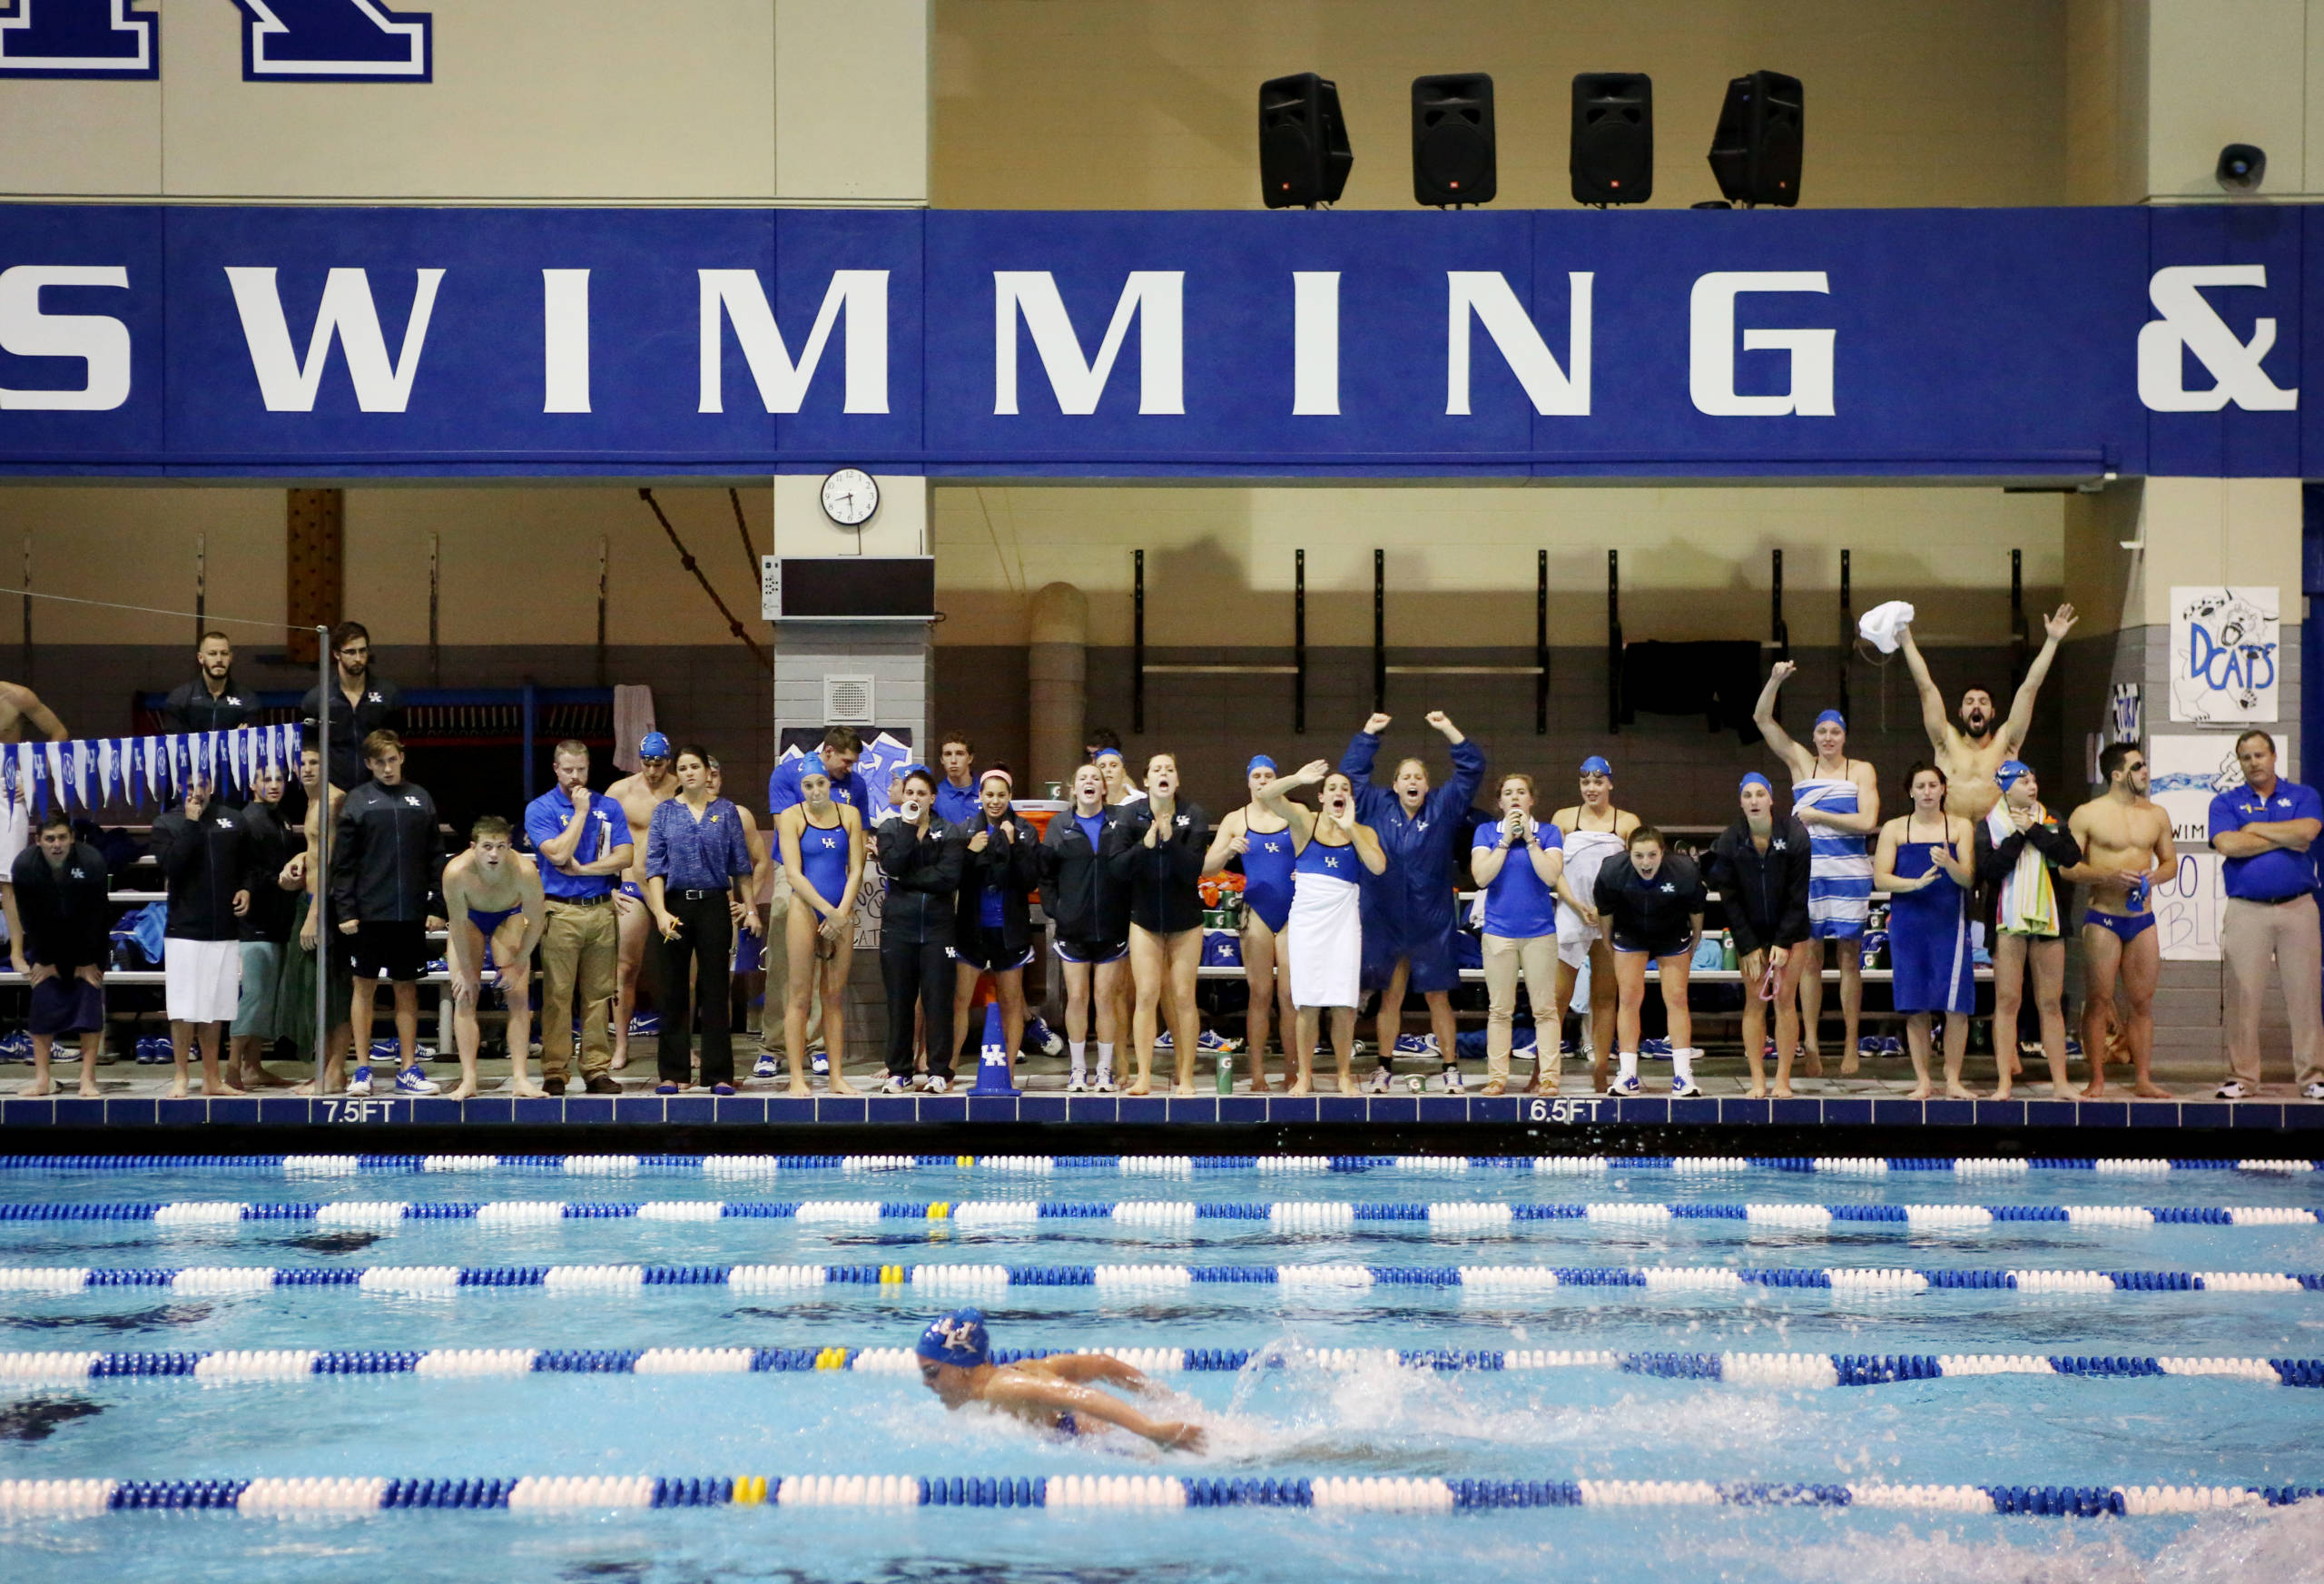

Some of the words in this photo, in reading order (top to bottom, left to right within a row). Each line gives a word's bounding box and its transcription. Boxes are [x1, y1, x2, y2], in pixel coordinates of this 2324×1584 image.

[0, 265, 1837, 418] SWIMMING
[2138, 264, 2298, 412] &
[2191, 622, 2277, 691] DCATS
[405, 795, 421, 807] UK
[2171, 824, 2204, 840] WIM
[822, 838, 835, 849] UK
[1265, 842, 1280, 853] UK
[1324, 857, 1338, 868] UK
[944, 946, 957, 959] UK
[1218, 944, 1235, 958] UK
[980, 1044, 1007, 1067] UK
[1220, 1057, 1233, 1069] G
